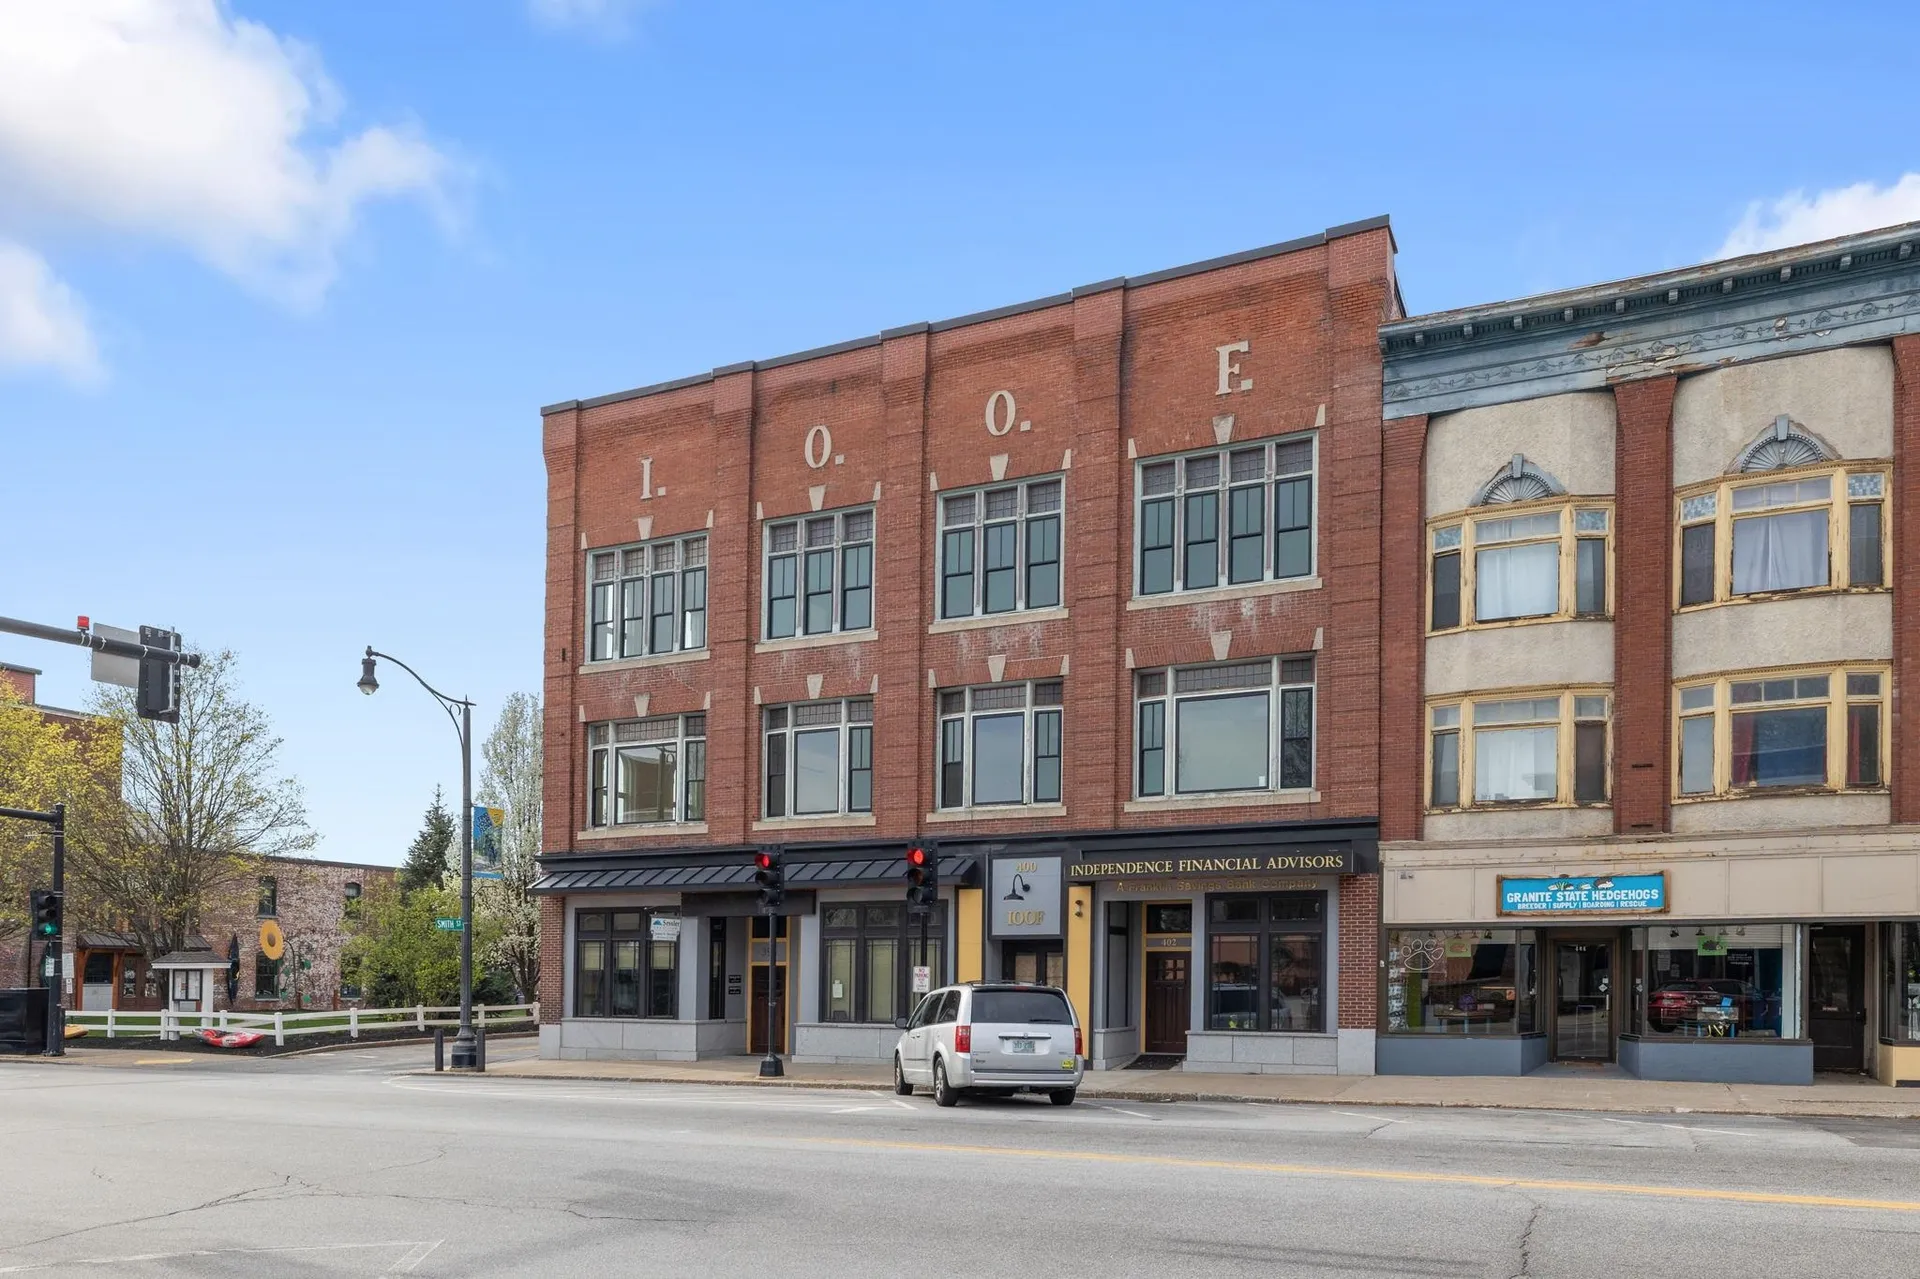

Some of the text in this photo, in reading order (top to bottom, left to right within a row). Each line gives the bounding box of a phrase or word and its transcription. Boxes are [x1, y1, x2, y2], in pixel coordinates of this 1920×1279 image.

[640, 340, 1253, 500] I. O. O. F.
[1016, 862, 1038, 873] 400
[1070, 855, 1344, 877] INDEPENDENCE FINANCIAL ADVISORS
[1116, 878, 1319, 892] A Franklin Savings Bank Company
[1506, 888, 1660, 903] GRANITE STATE HEDGEHOGS
[1517, 900, 1648, 910] BREEDER SUPPLY BOARDING RESCUE
[437, 919, 455, 929] SMITH
[1007, 910, 1046, 926] IOOF
[1161, 938, 1178, 946] 402
